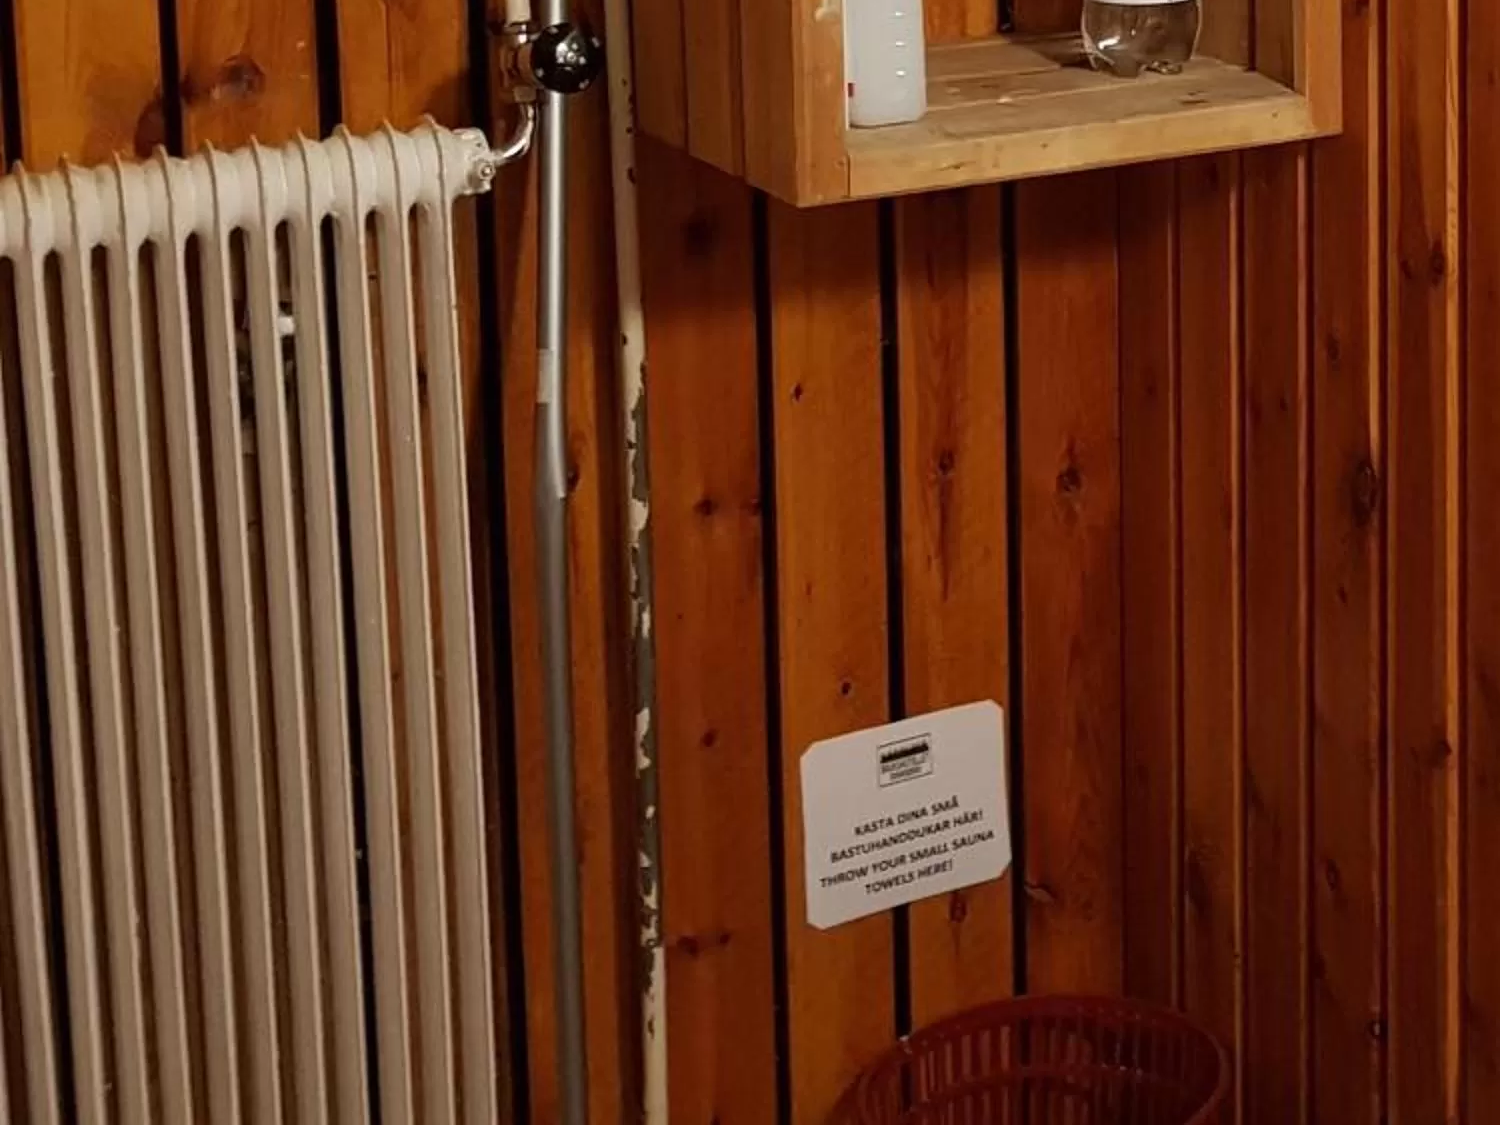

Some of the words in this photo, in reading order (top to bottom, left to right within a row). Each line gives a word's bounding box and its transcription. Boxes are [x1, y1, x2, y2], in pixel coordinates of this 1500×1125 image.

[830, 820, 950, 864] BASTUHANDDUKAR
[953, 808, 984, 828] HÄR!
[854, 818, 894, 836] KASTA
[897, 806, 928, 825] DINA
[931, 795, 959, 816] SMÅ
[820, 867, 869, 888] THROW
[872, 855, 906, 874] YOUR
[909, 844, 950, 864] SMALL
[952, 830, 995, 851] SAUNA
[865, 873, 915, 895] TOWELS
[918, 859, 953, 878] HERE!
